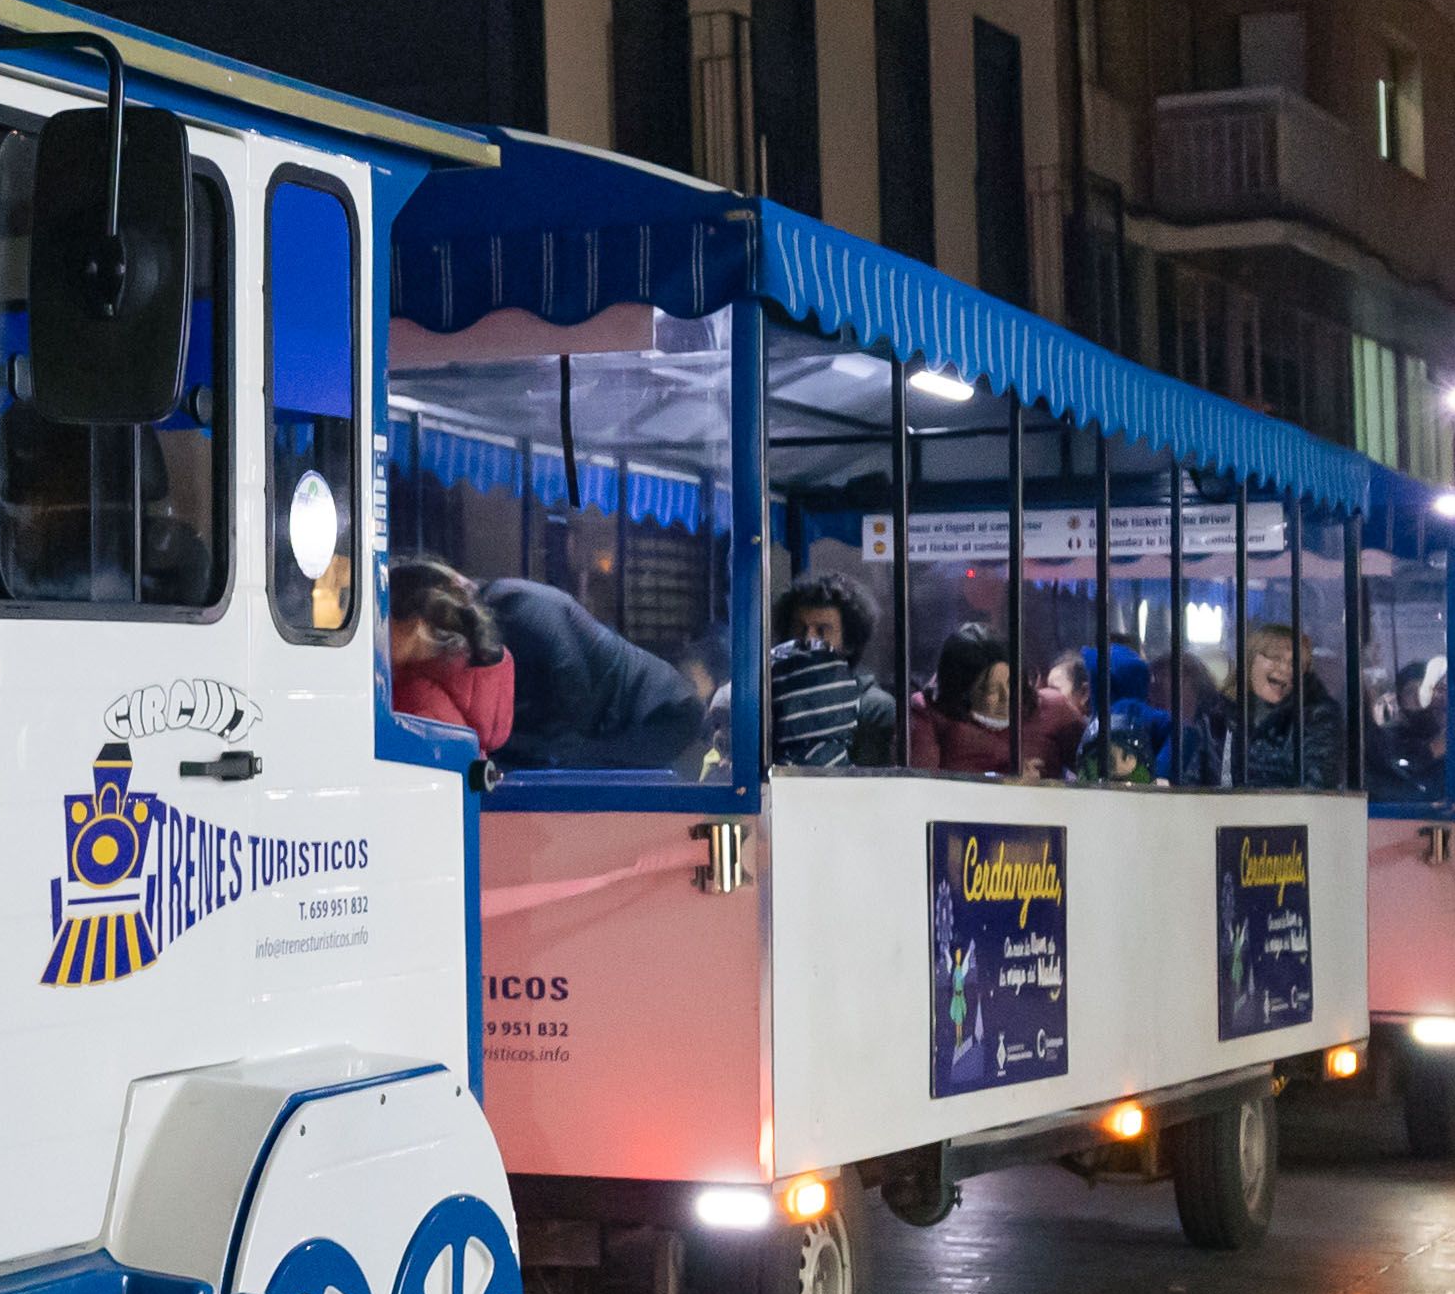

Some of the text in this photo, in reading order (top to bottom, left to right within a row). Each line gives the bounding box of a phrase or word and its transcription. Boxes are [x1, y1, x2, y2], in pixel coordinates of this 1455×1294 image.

[104, 679, 263, 743] CIRCUIT
[153, 799, 368, 955] TRENES TURISTICOS
[963, 836, 1063, 929] Cerdanyola,
[299, 896, 368, 921] T. 659 951 832
[255, 925, 368, 958] info@trenesturisticos.info
[483, 975, 568, 1000] ICOS
[502, 1021, 530, 1036] 951
[537, 1021, 568, 1037] 832
